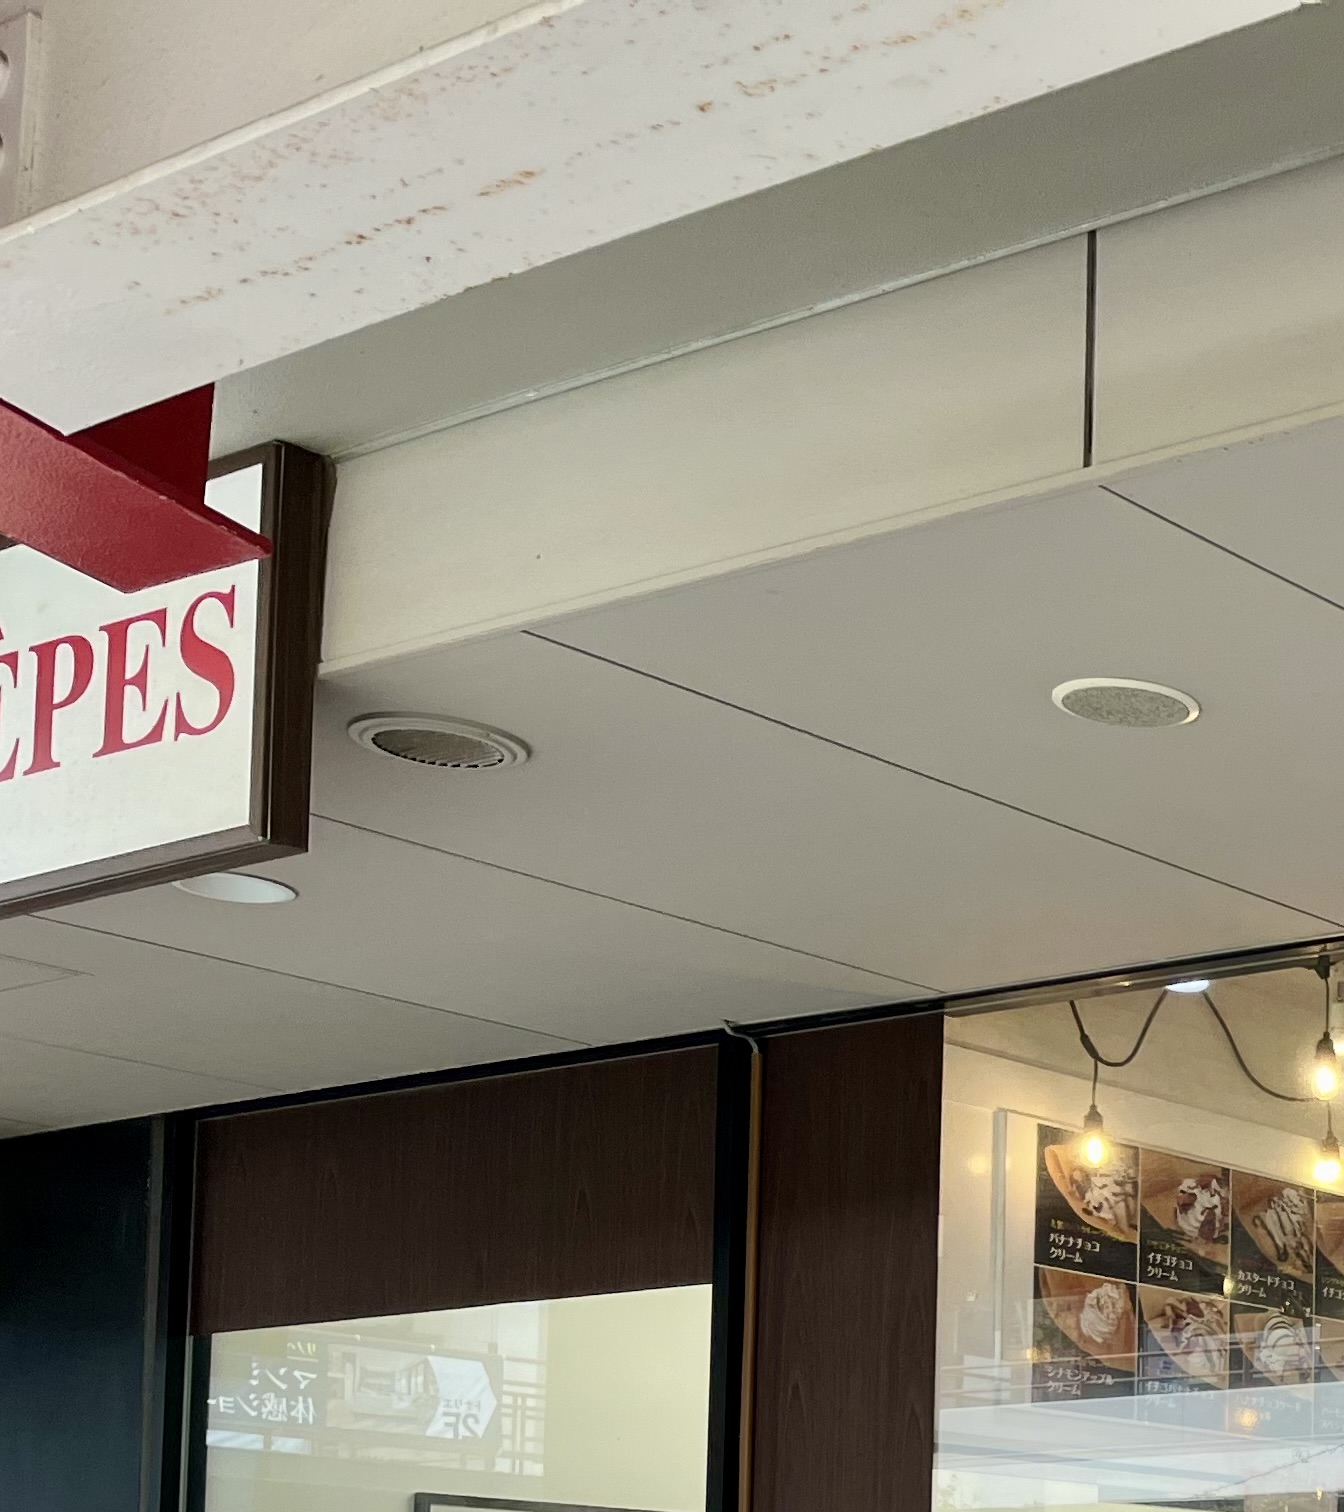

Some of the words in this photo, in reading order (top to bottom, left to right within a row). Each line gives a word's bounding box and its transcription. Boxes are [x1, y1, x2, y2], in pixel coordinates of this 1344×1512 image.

[1049, 1248, 1083, 1263] クリーム
[1146, 1252, 1193, 1271] イチゴチョコ
[1146, 1266, 1179, 1282] クリーム
[1237, 1283, 1267, 1298] クリーム
